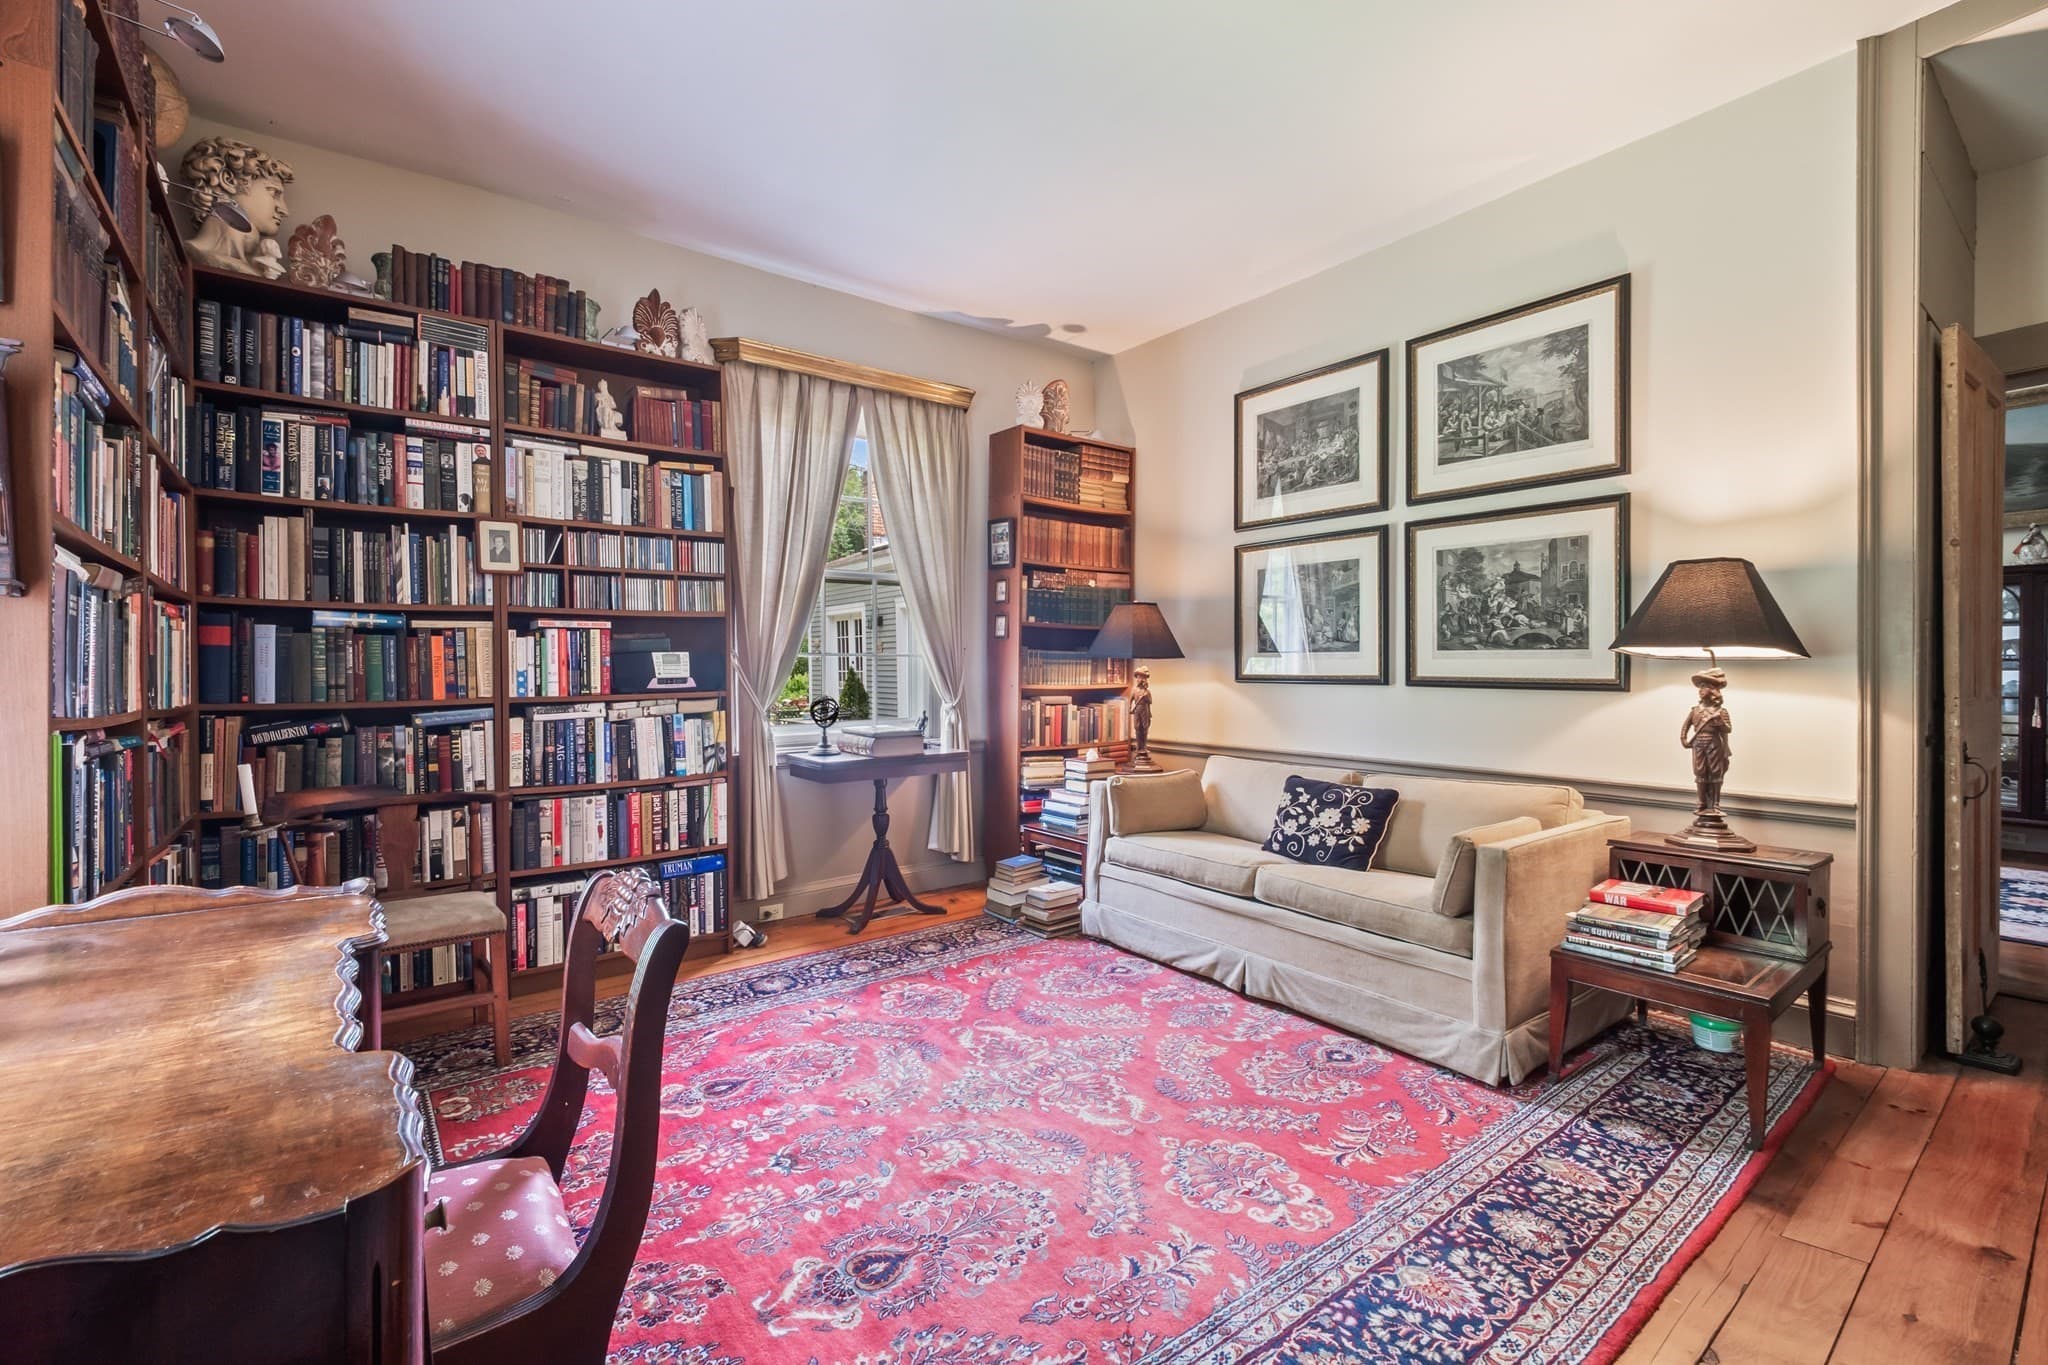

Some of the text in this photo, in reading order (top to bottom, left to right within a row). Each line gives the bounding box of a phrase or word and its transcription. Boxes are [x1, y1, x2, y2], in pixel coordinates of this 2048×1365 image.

[225, 328, 236, 365] JACKSON
[245, 328, 255, 366] THOREAU
[286, 422, 301, 463] Kennedys
[580, 480, 588, 512] ARBURGS
[674, 488, 683, 521] LINDBERGH
[250, 724, 310, 745] DAVID HALBERSTAM
[417, 728, 425, 758] CHURCHILL
[450, 737, 462, 762] TITO
[556, 743, 566, 761] AIG
[663, 860, 693, 874] TRUMAN
[1604, 893, 1627, 906] WAR
[1590, 927, 1632, 942] SURVIVOR
